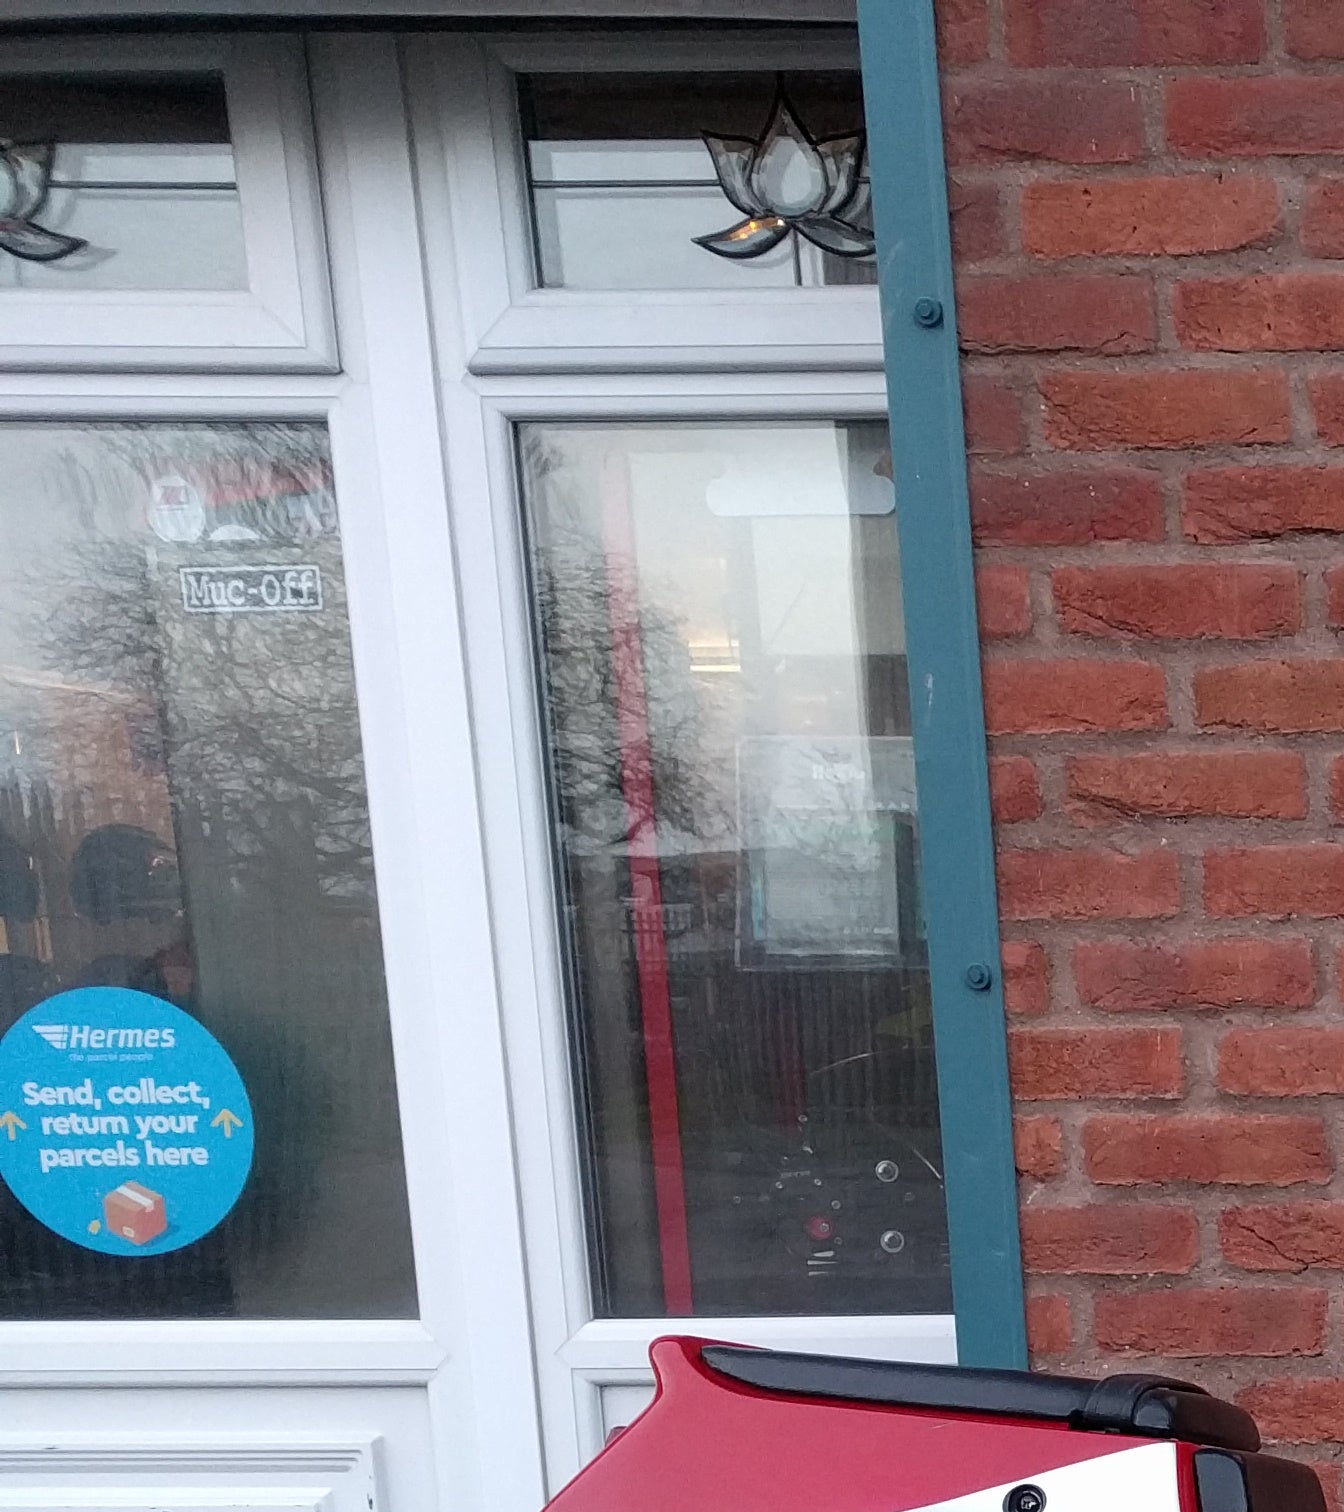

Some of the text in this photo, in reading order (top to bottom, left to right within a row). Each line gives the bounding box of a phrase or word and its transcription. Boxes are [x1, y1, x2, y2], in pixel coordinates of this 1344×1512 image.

[187, 571, 315, 606] Muc-Off
[69, 1025, 176, 1050] Hermes
[22, 1077, 210, 1110] Send, collect,
[41, 1112, 199, 1140] return your
[40, 1140, 209, 1173] parcels here
